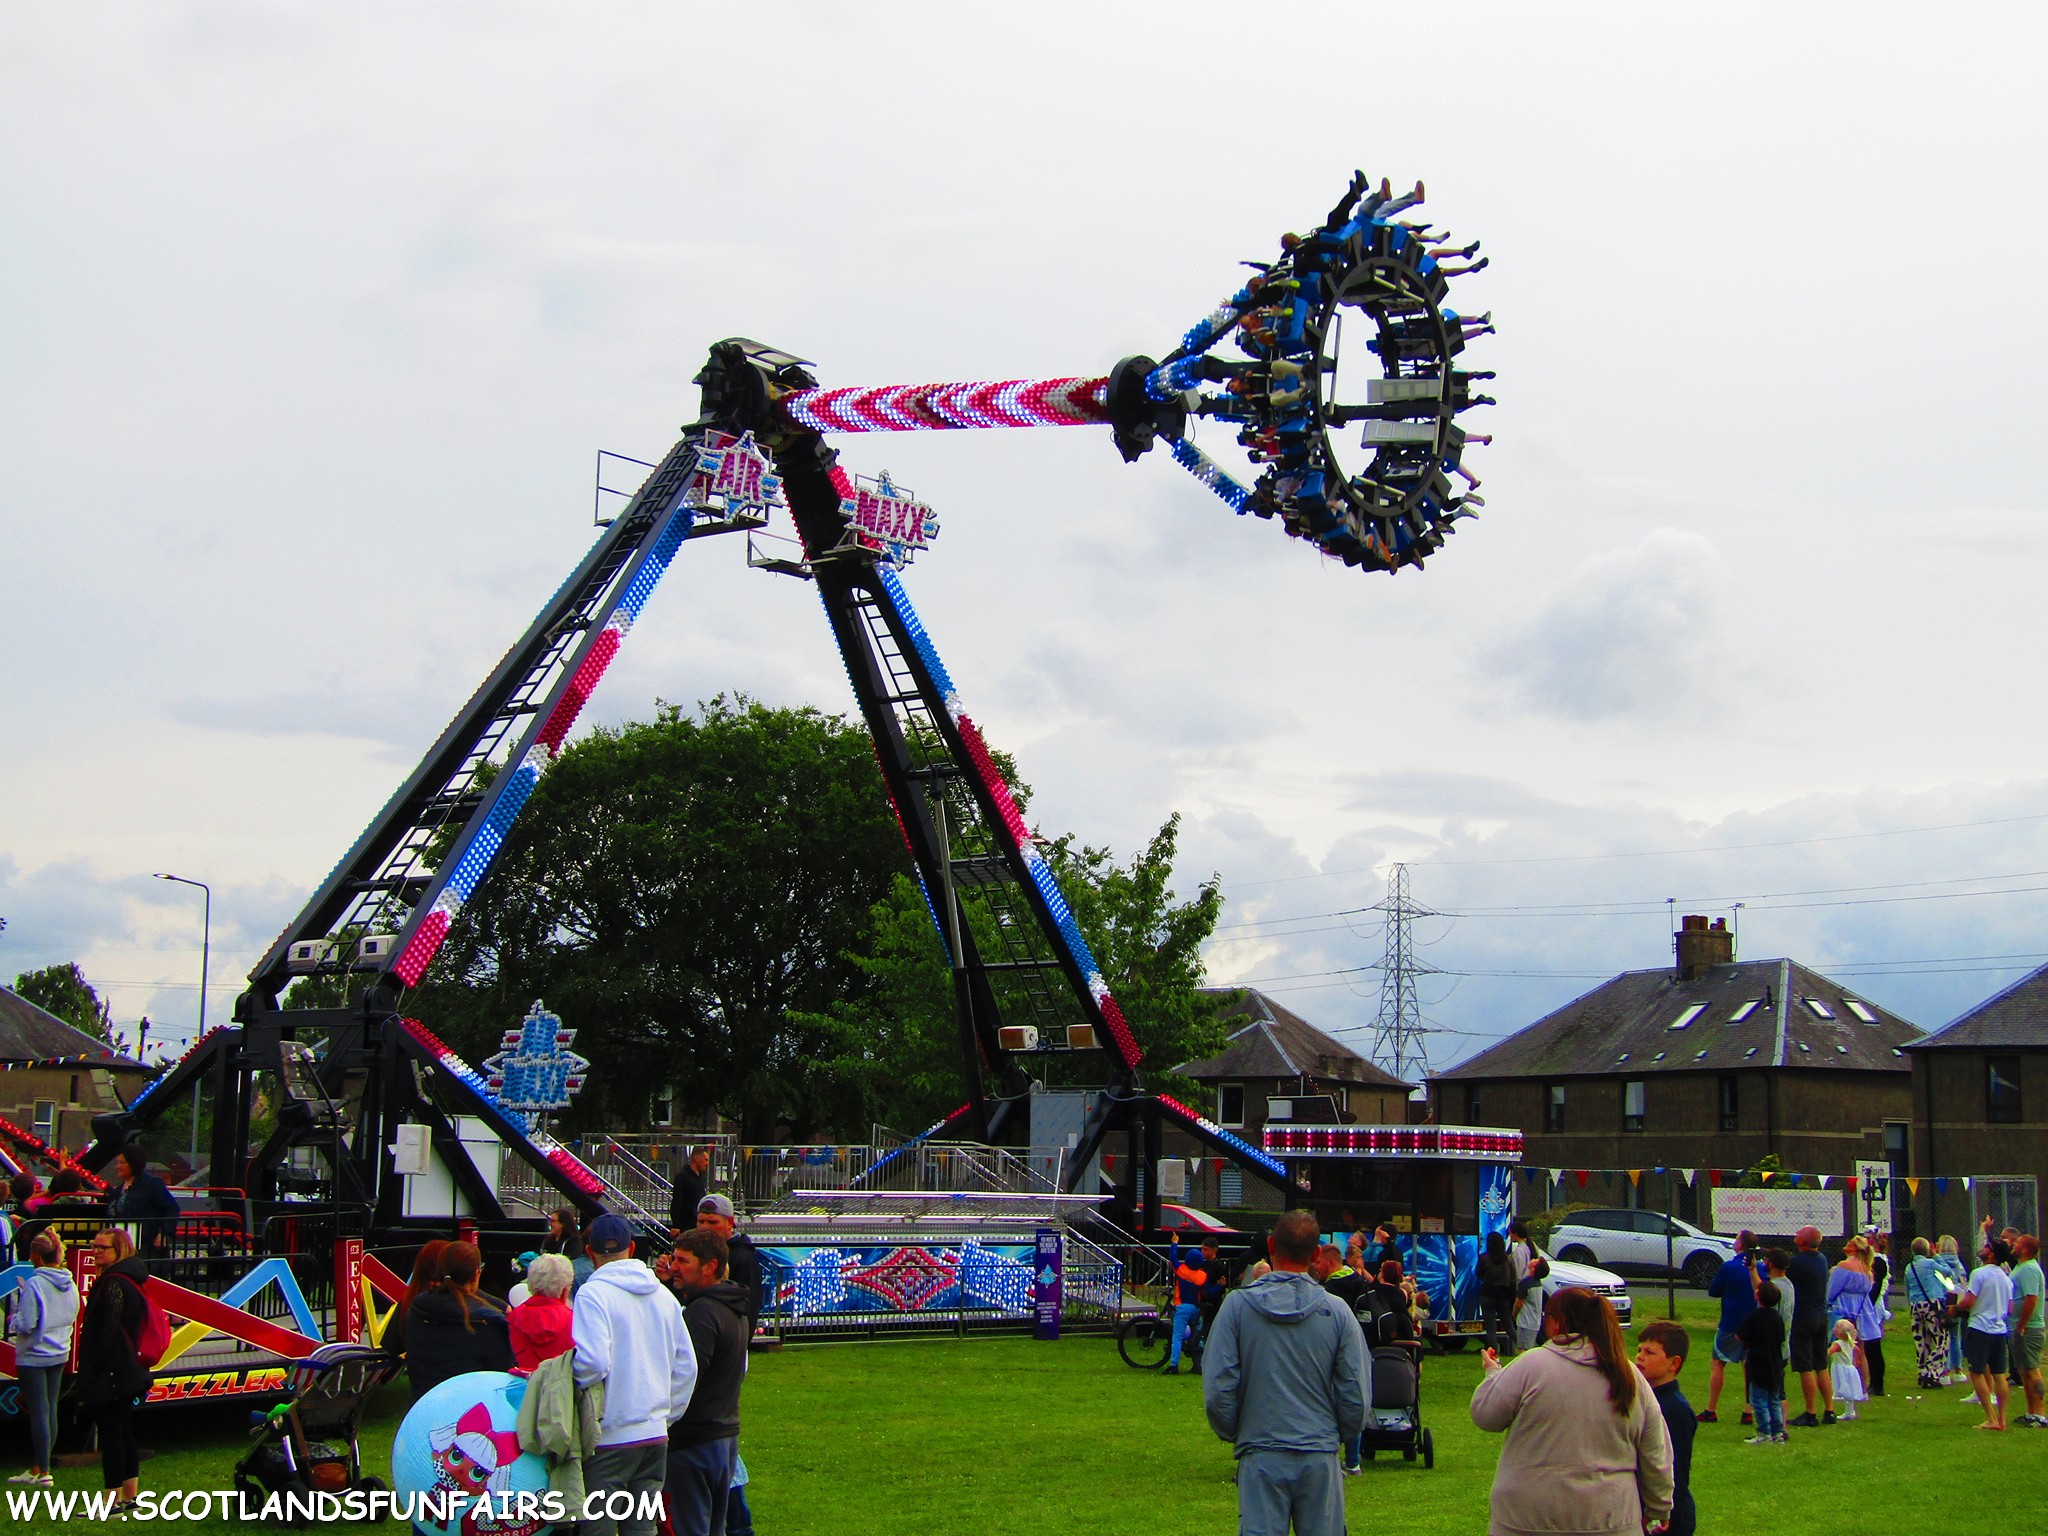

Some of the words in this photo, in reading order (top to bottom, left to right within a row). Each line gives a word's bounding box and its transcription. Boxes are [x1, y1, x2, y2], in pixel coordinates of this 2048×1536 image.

[716, 451, 762, 501] AIR
[856, 490, 927, 542] MAXX
[350, 1261, 361, 1344] EVANS
[145, 1367, 287, 1403] SIZZLER
